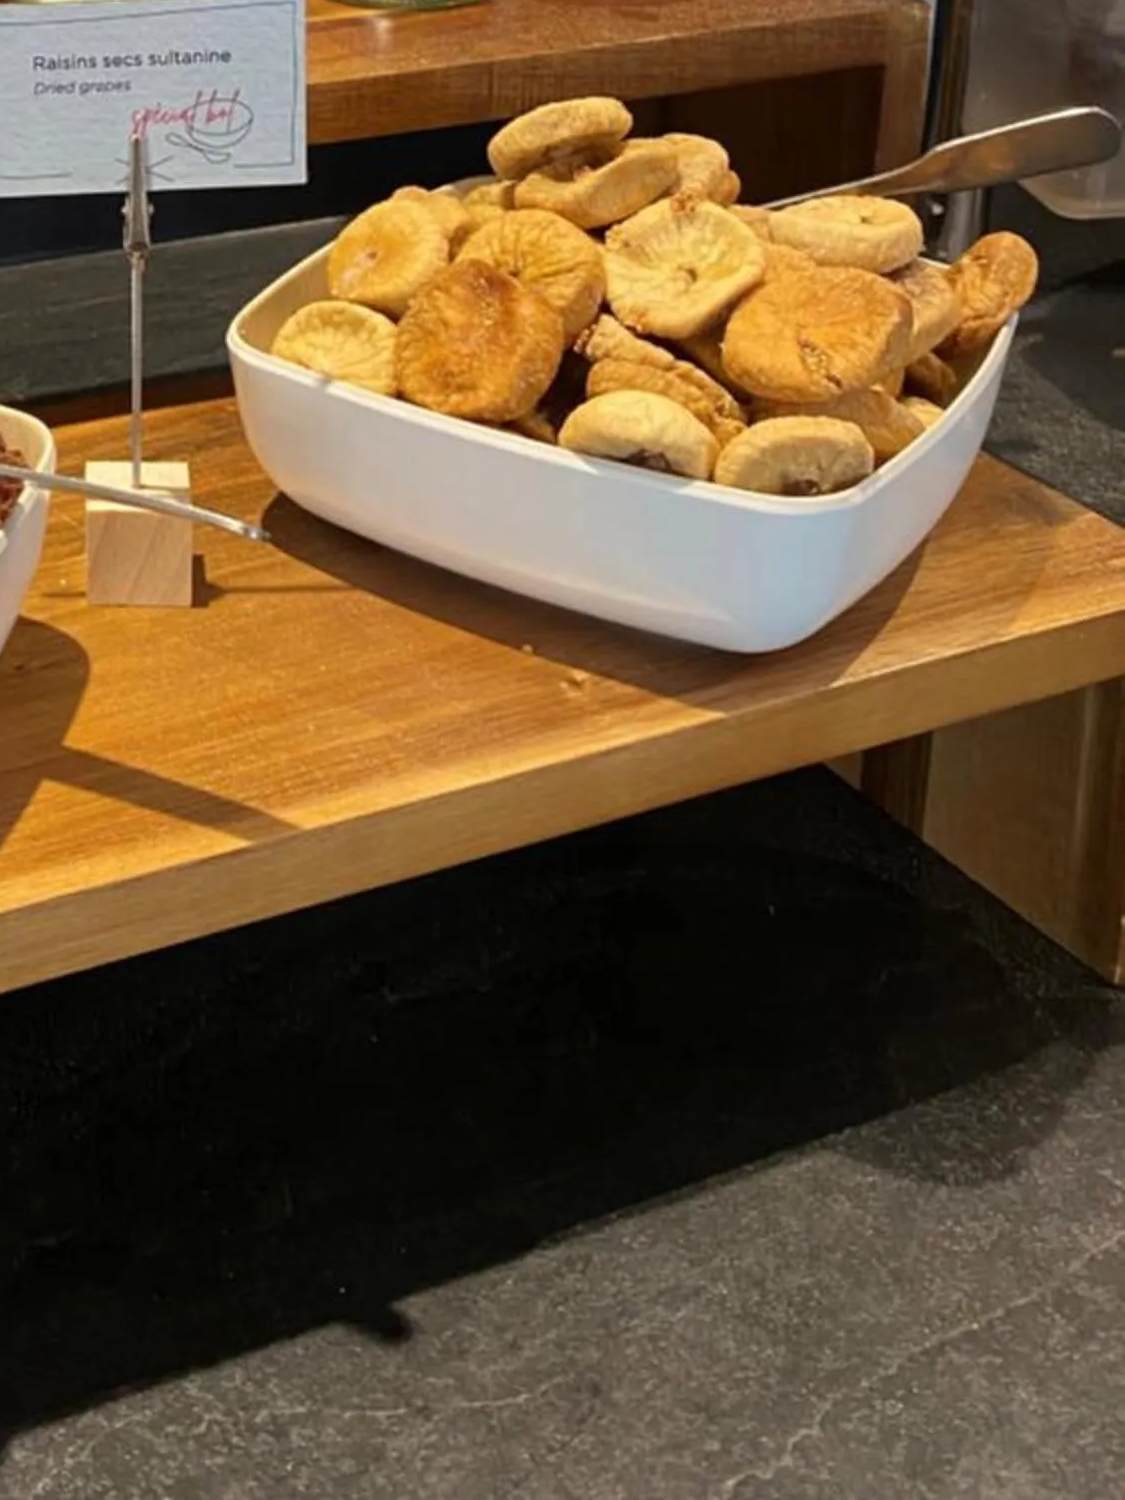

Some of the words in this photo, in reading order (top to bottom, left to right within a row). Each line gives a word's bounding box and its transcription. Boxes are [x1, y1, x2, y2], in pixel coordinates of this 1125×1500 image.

[32, 54, 97, 71] Raisins
[103, 54, 144, 69] secs
[148, 49, 233, 68] sultanine
[33, 79, 76, 96] Dried
[78, 79, 132, 99] grapes
